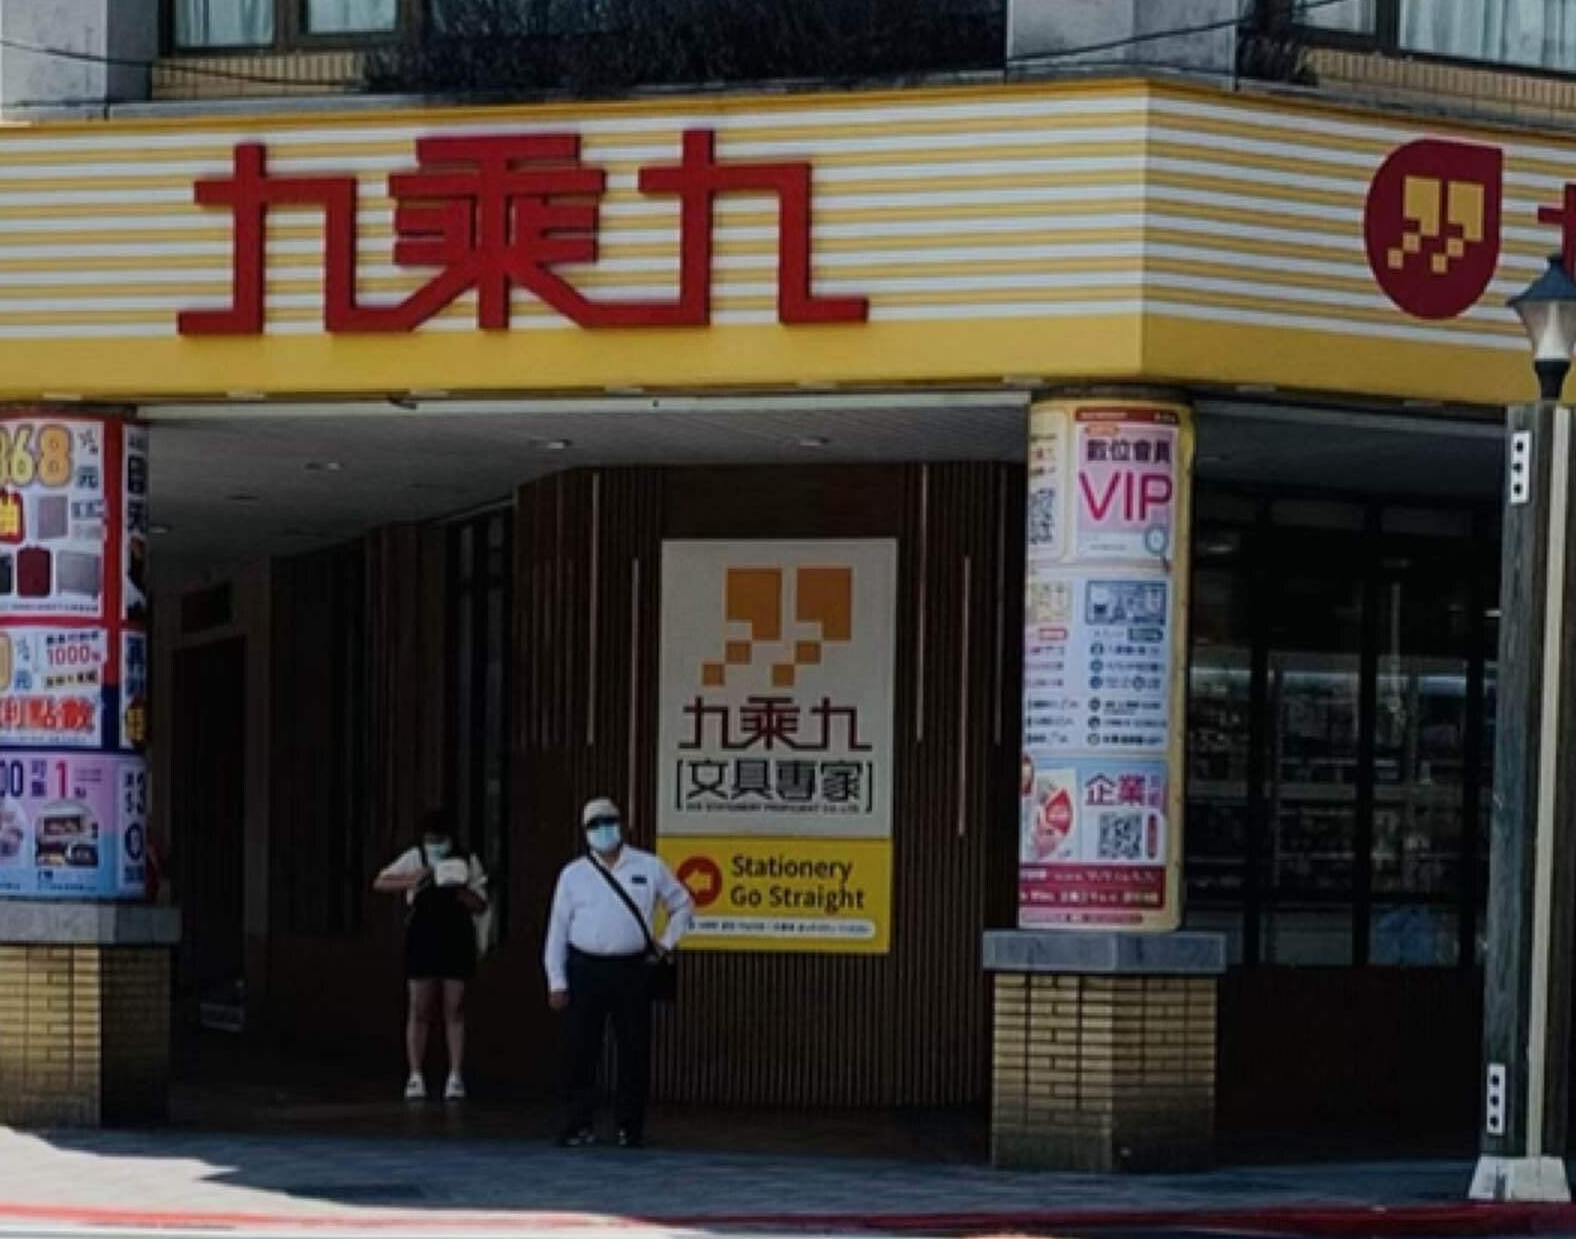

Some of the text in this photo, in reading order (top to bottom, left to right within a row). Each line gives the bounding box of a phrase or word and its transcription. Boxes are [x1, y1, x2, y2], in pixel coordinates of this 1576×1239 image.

[177, 128, 870, 335] 九乘九
[1079, 470, 1173, 521] VIP
[677, 696, 873, 752] 九乘九
[686, 758, 863, 802] 文具專家
[731, 853, 853, 883] Stationery
[730, 886, 865, 914] Go Straight
